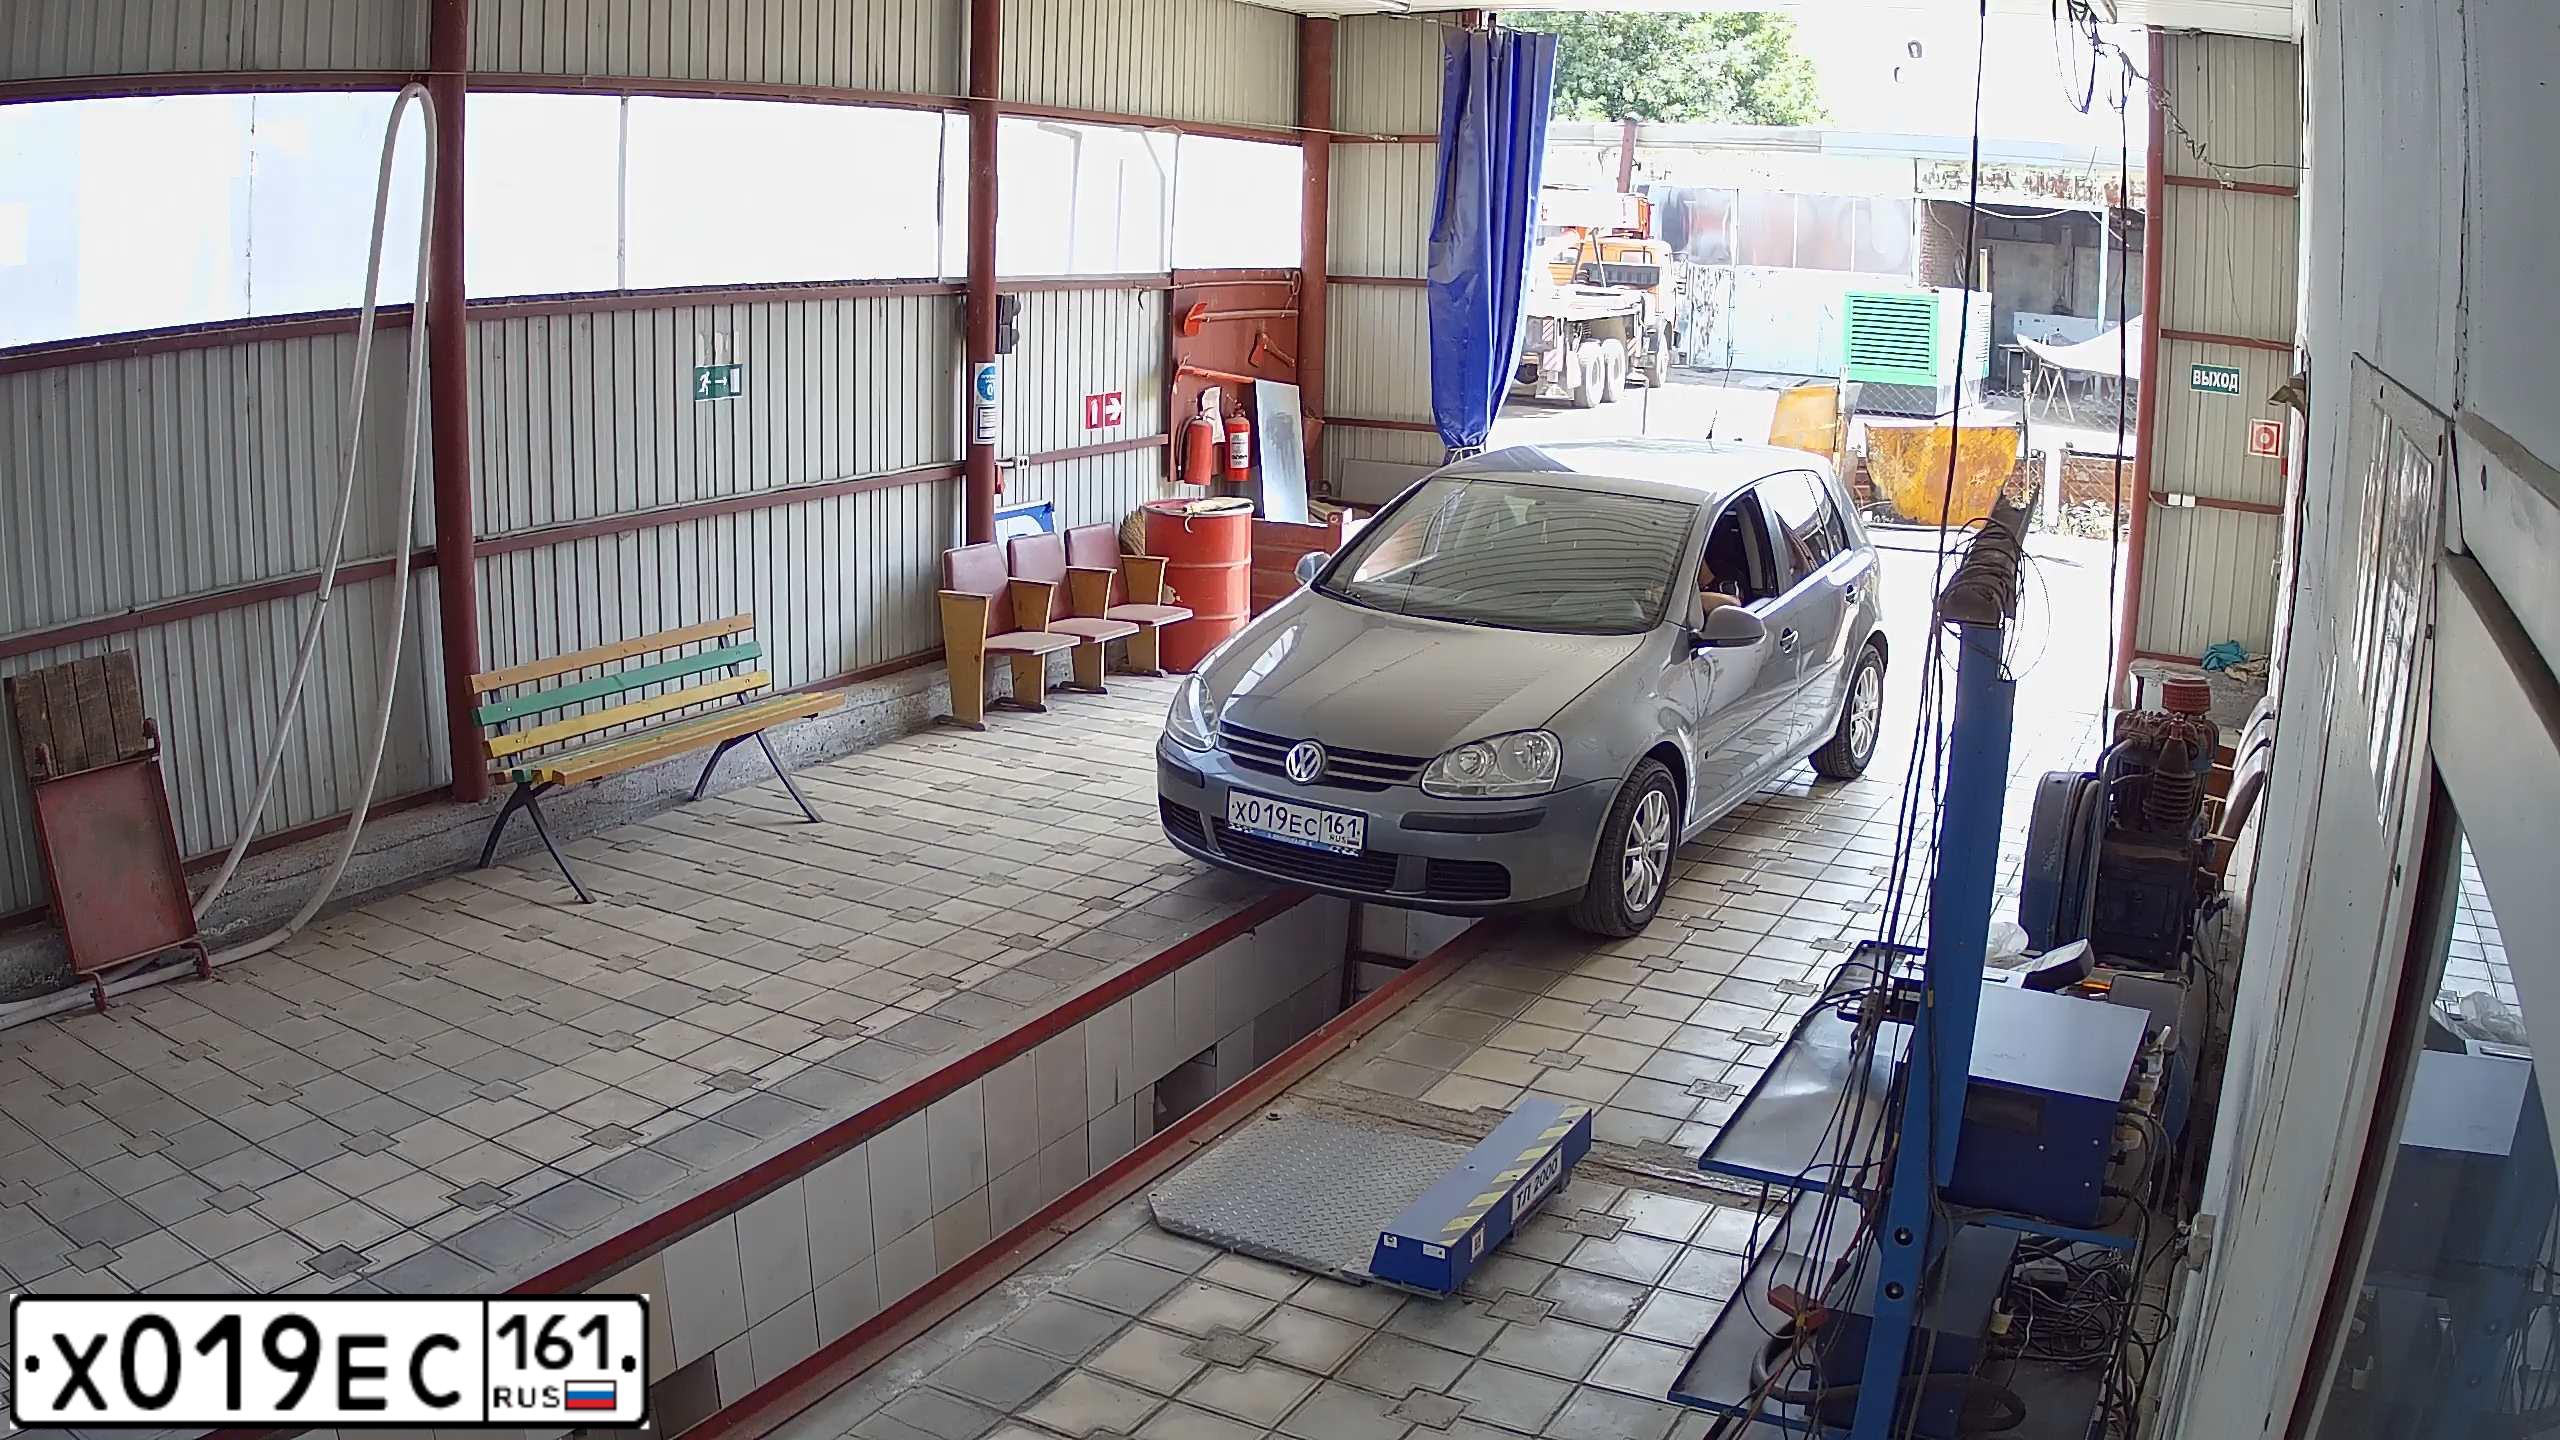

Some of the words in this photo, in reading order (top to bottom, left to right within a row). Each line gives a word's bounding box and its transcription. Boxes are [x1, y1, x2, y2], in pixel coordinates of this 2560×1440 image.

[2192, 369, 2238, 392] ВЫХОД
[1323, 814, 1357, 838] 161
[1533, 1157, 1558, 1194] 2000
